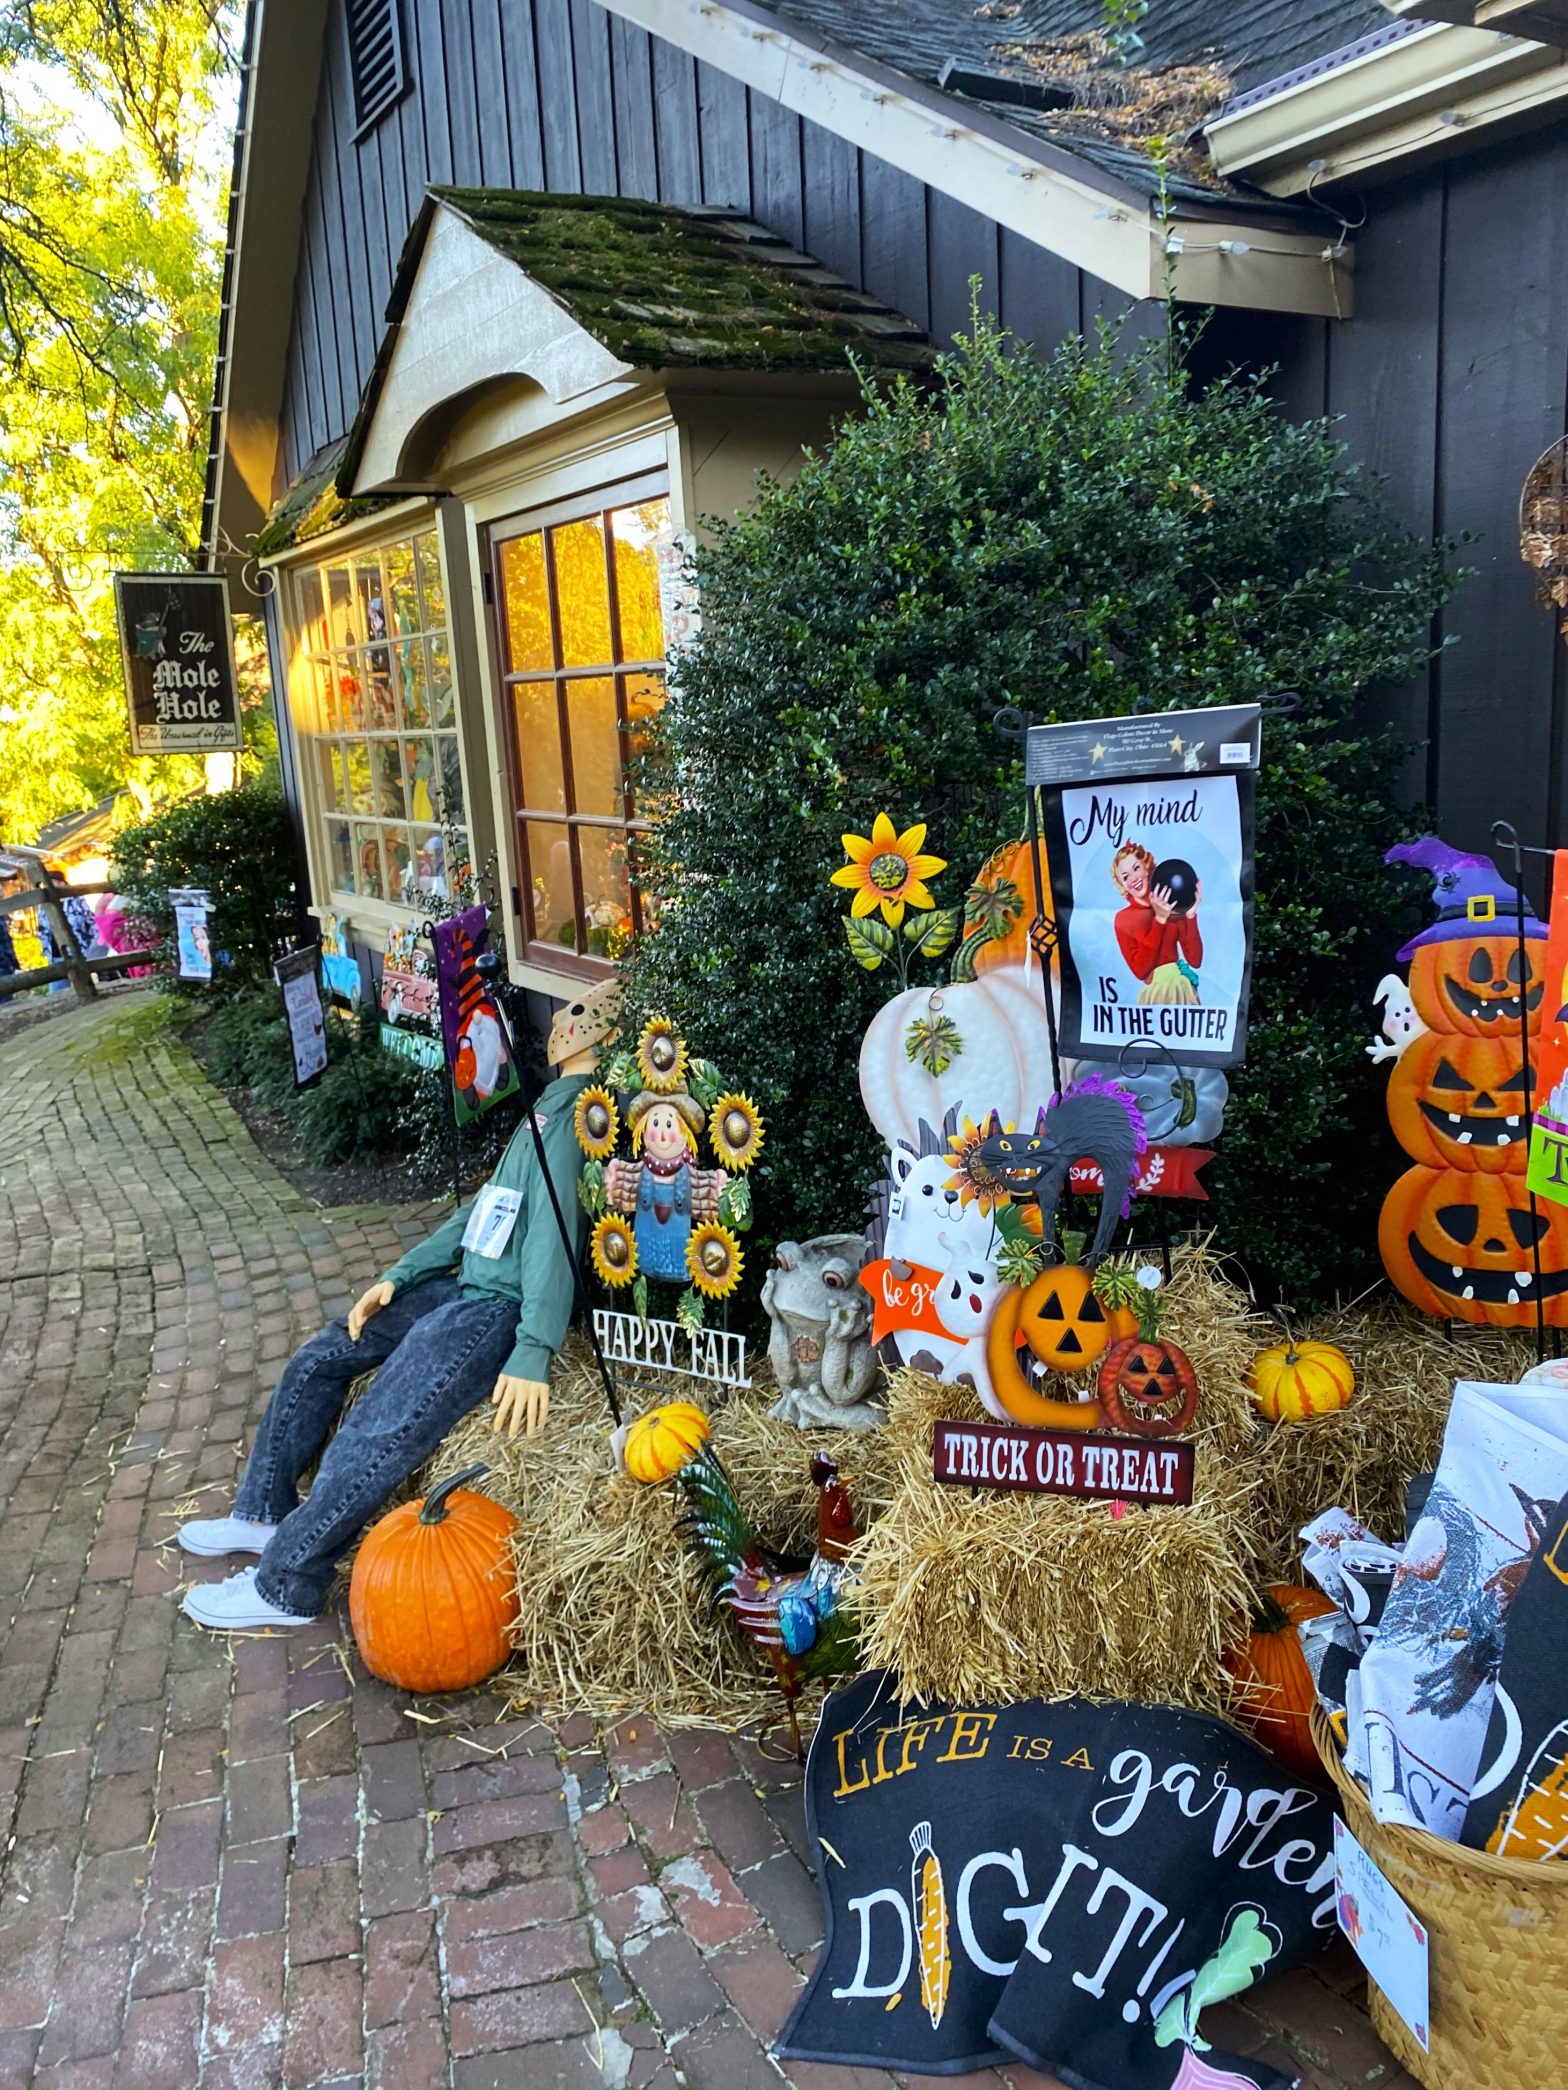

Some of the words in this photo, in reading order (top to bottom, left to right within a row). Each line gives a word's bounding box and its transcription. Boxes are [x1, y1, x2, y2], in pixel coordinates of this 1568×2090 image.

[179, 631, 215, 654] The
[153, 659, 221, 691] Mole
[154, 690, 222, 724] Hole
[1070, 795, 1129, 848] My
[1136, 789, 1204, 827] mind
[1099, 976, 1119, 1004] IS
[1093, 1005, 1114, 1034] IN
[1120, 1007, 1154, 1036] THE
[1160, 1007, 1228, 1041] GUTTER
[883, 1268, 909, 1308] be
[593, 1309, 677, 1370] HAPPY
[691, 1326, 752, 1388] FALL
[944, 1433, 1030, 1482] TRICK
[1036, 1441, 1075, 1487] OR
[1082, 1446, 1179, 1495] TREAT
[832, 1712, 998, 1798] LIFE
[1006, 1735, 1053, 1760] IS
[1061, 1747, 1095, 1771] A
[1358, 1849, 1384, 1893] RUGS
